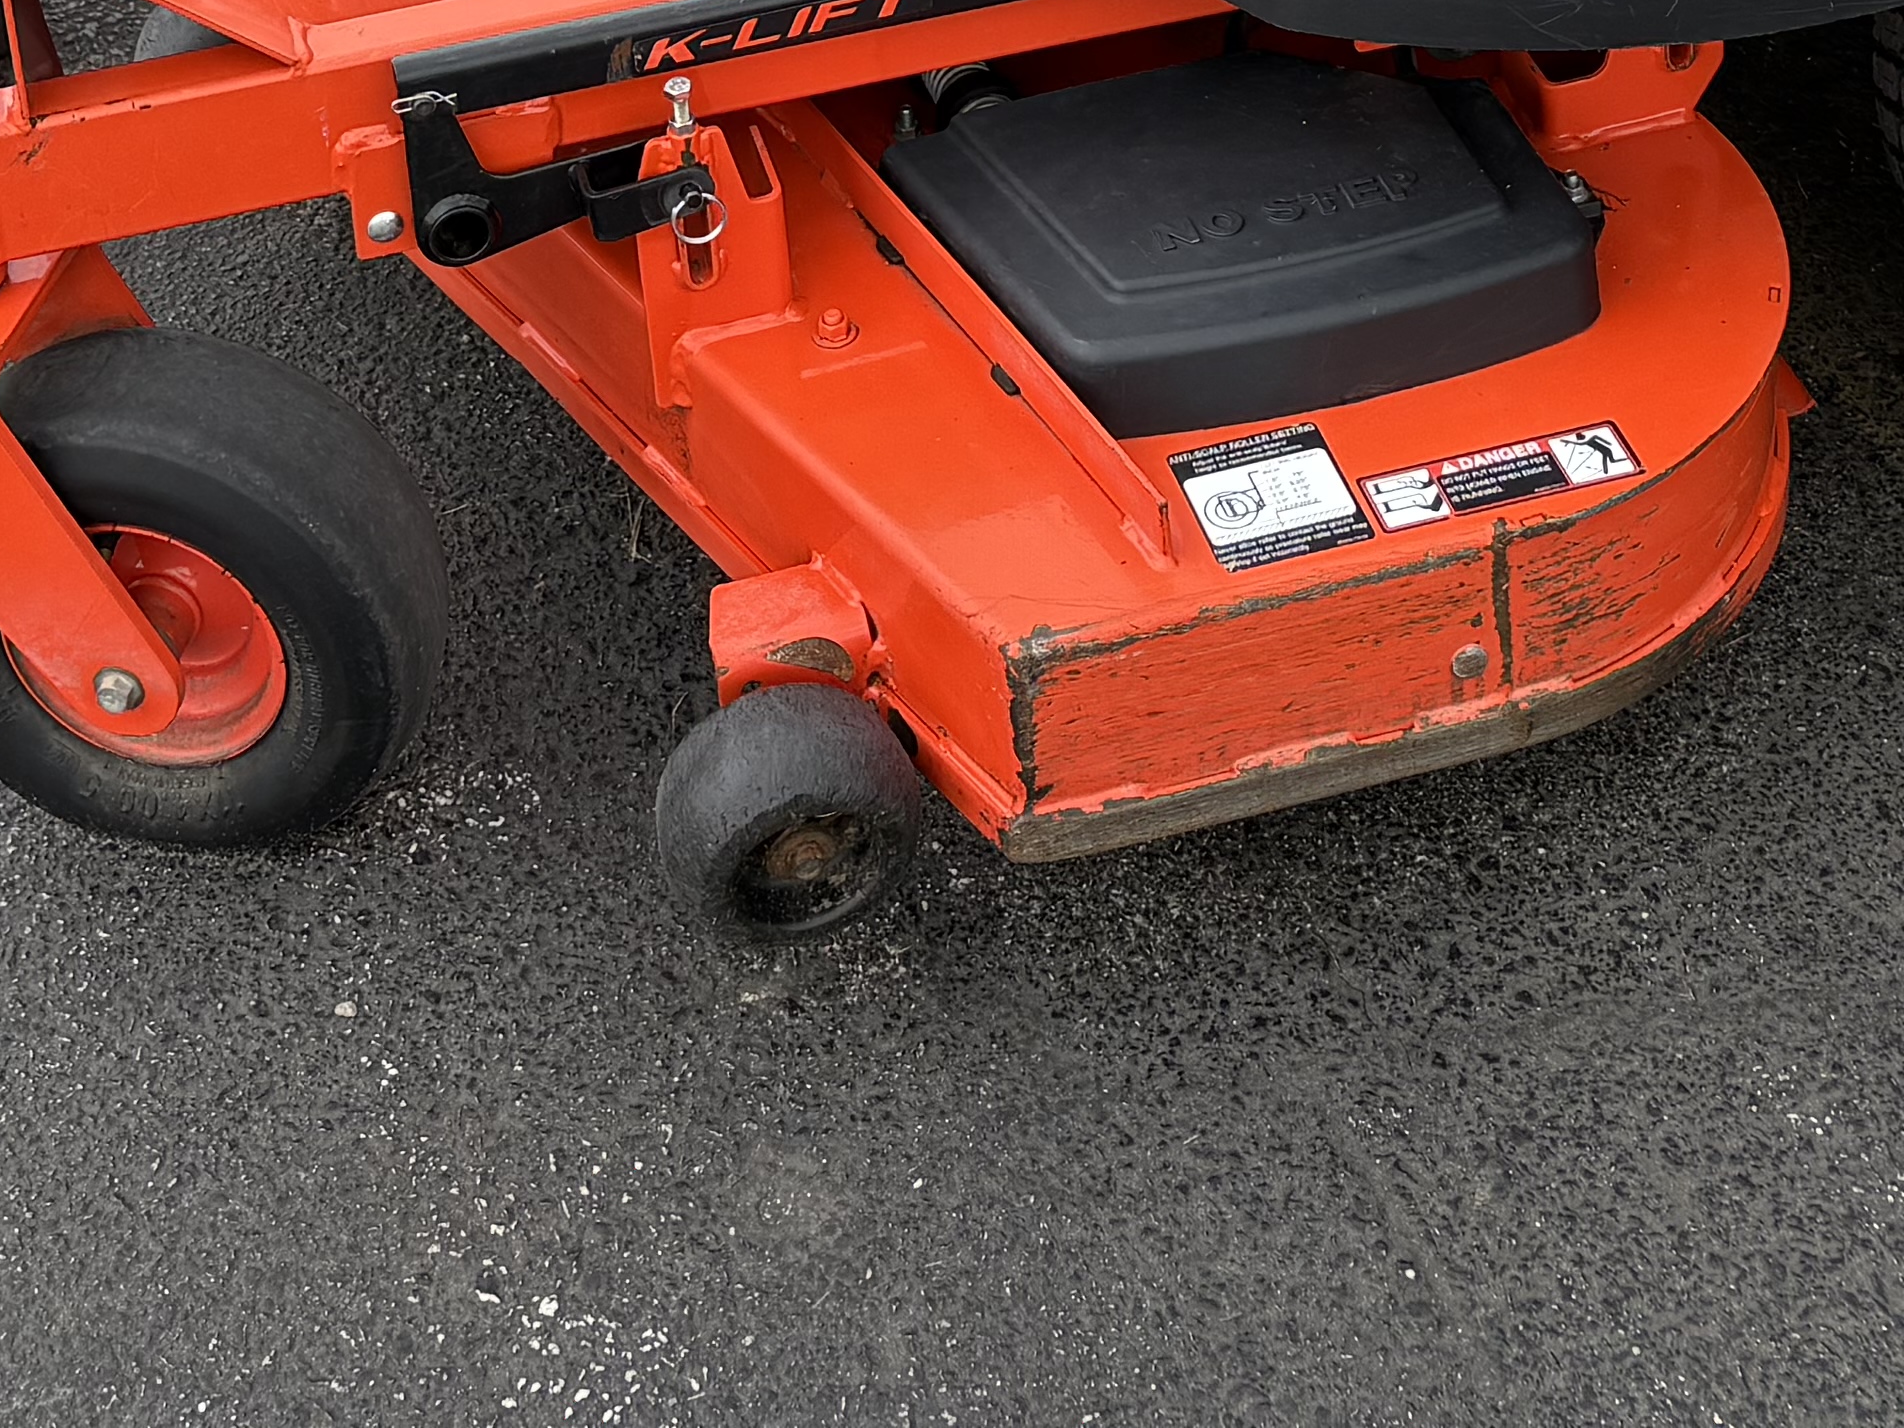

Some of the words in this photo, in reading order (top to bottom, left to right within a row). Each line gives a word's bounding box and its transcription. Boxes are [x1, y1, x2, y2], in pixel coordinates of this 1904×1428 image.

[1151, 208, 1246, 252] NO
[1262, 168, 1419, 224] STEP
[1457, 441, 1543, 472] DANGER
